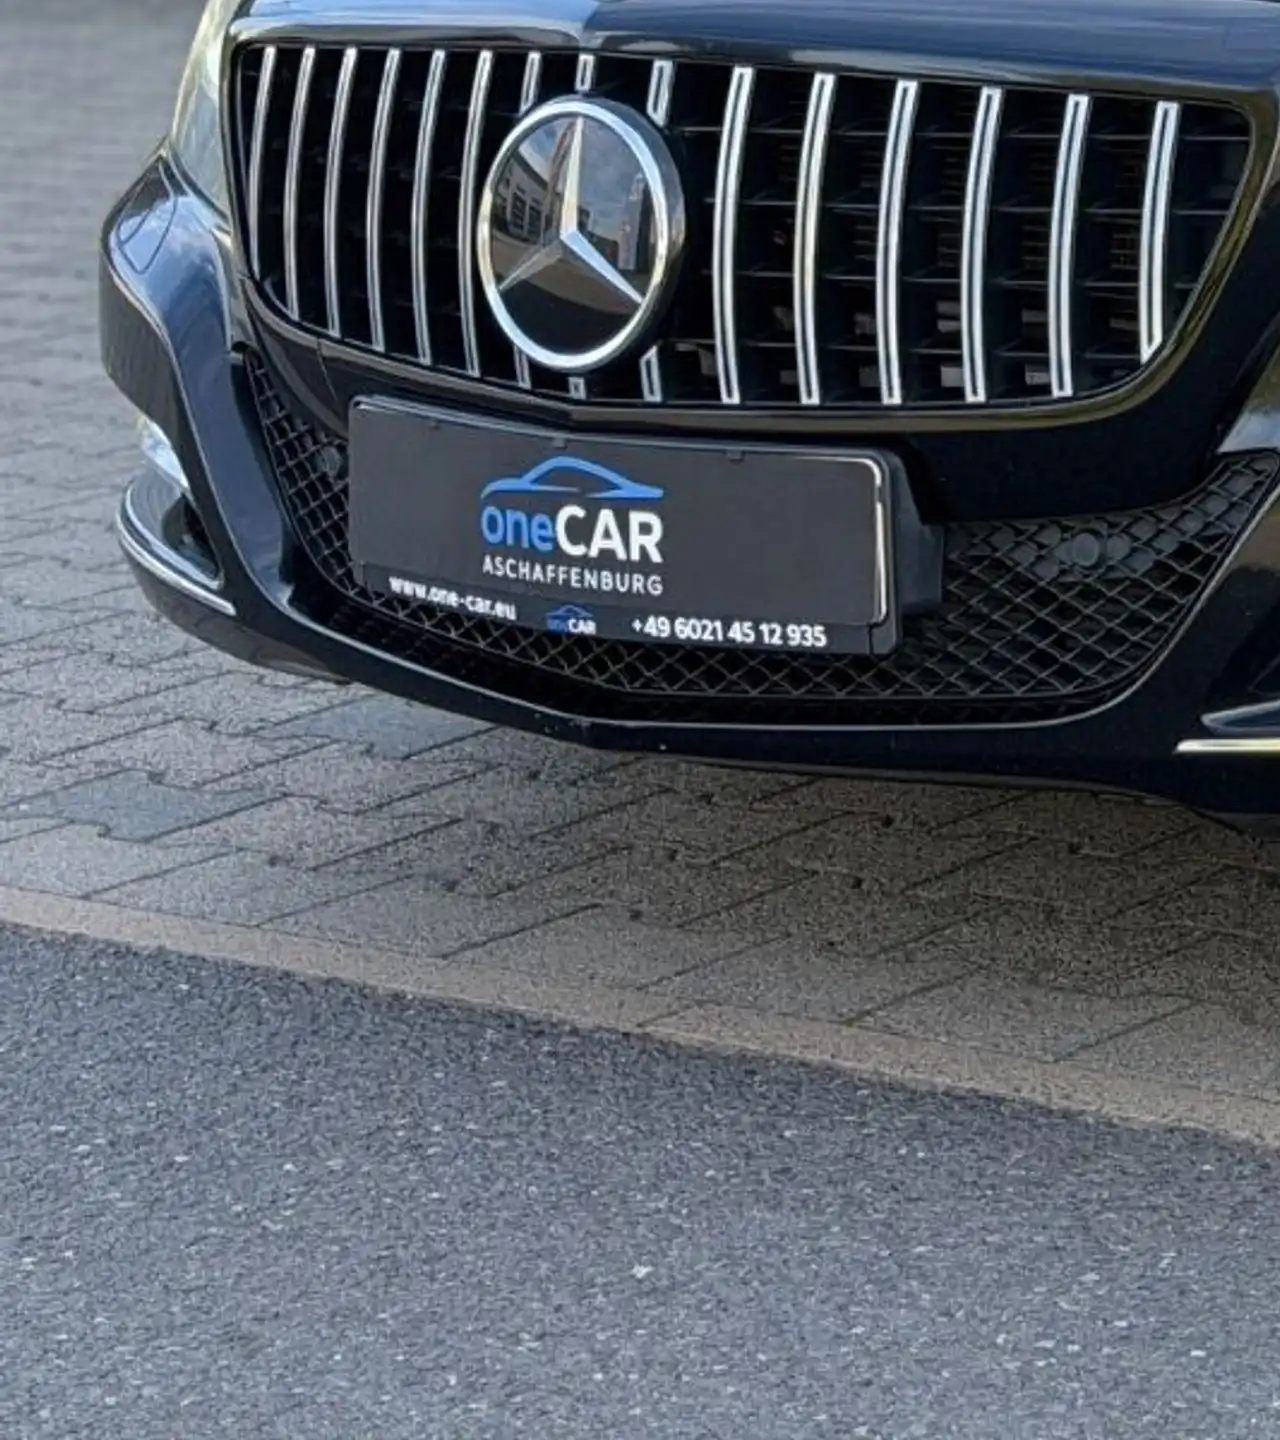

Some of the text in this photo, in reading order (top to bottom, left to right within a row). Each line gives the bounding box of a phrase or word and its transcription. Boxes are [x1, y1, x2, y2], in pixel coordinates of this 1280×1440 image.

[481, 504, 664, 564] oneCAR
[482, 554, 664, 596] ASCHAFFENBURG
[388, 576, 517, 621] www.one-car.eu
[631, 615, 828, 648] +49 6021 45 12 935
